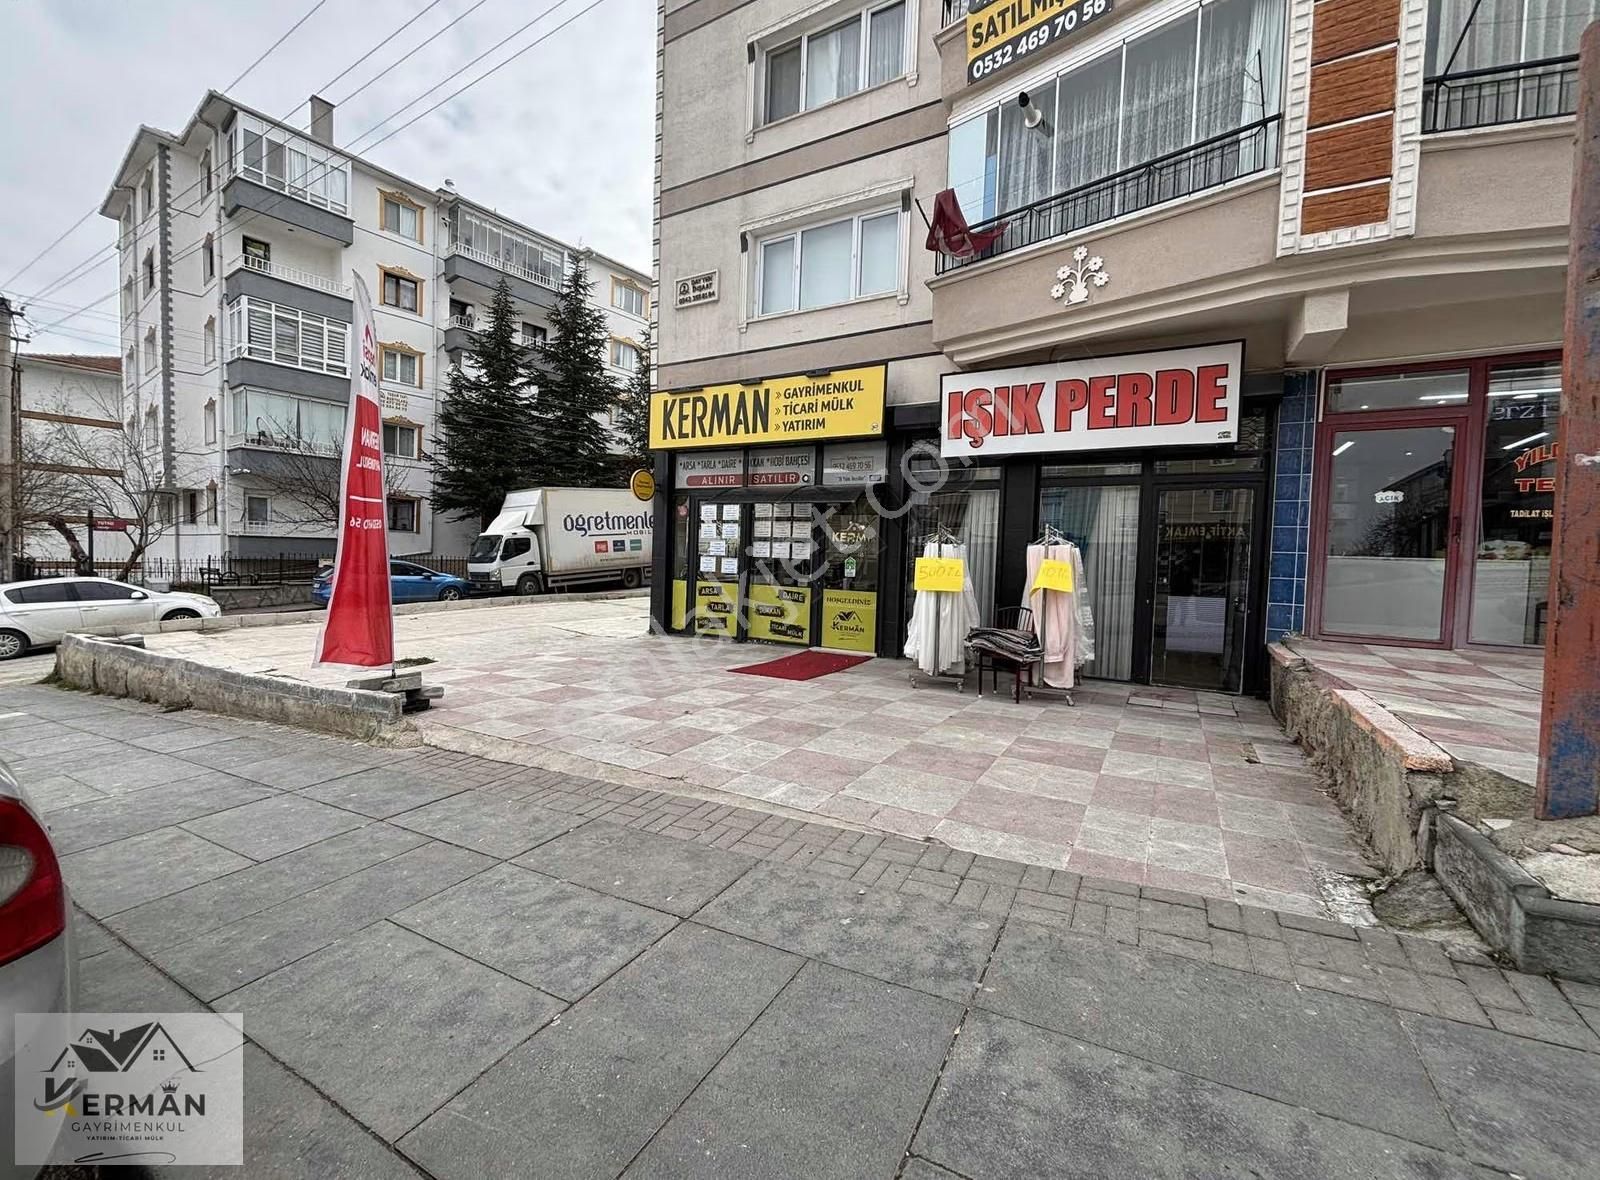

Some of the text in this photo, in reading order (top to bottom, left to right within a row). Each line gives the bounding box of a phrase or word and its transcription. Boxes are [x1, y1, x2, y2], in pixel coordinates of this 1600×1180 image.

[971, 0, 1064, 49] SATILM
[972, 0, 1105, 79] 0532 469 70 56
[662, 379, 864, 440] KERMAN GAYRİMENKUL
[783, 397, 854, 416] TİCARİ MÜLK
[947, 363, 1229, 449] IŞIK PERDE
[782, 417, 826, 432] YATIRIM
[683, 461, 696, 471] ARSA
[701, 459, 717, 469] TARLA
[702, 473, 797, 485] ALINIR SATILIR
[1510, 509, 1540, 518] TADİLAT
[701, 586, 718, 595] ARSA
[710, 604, 730, 612] TARLA
